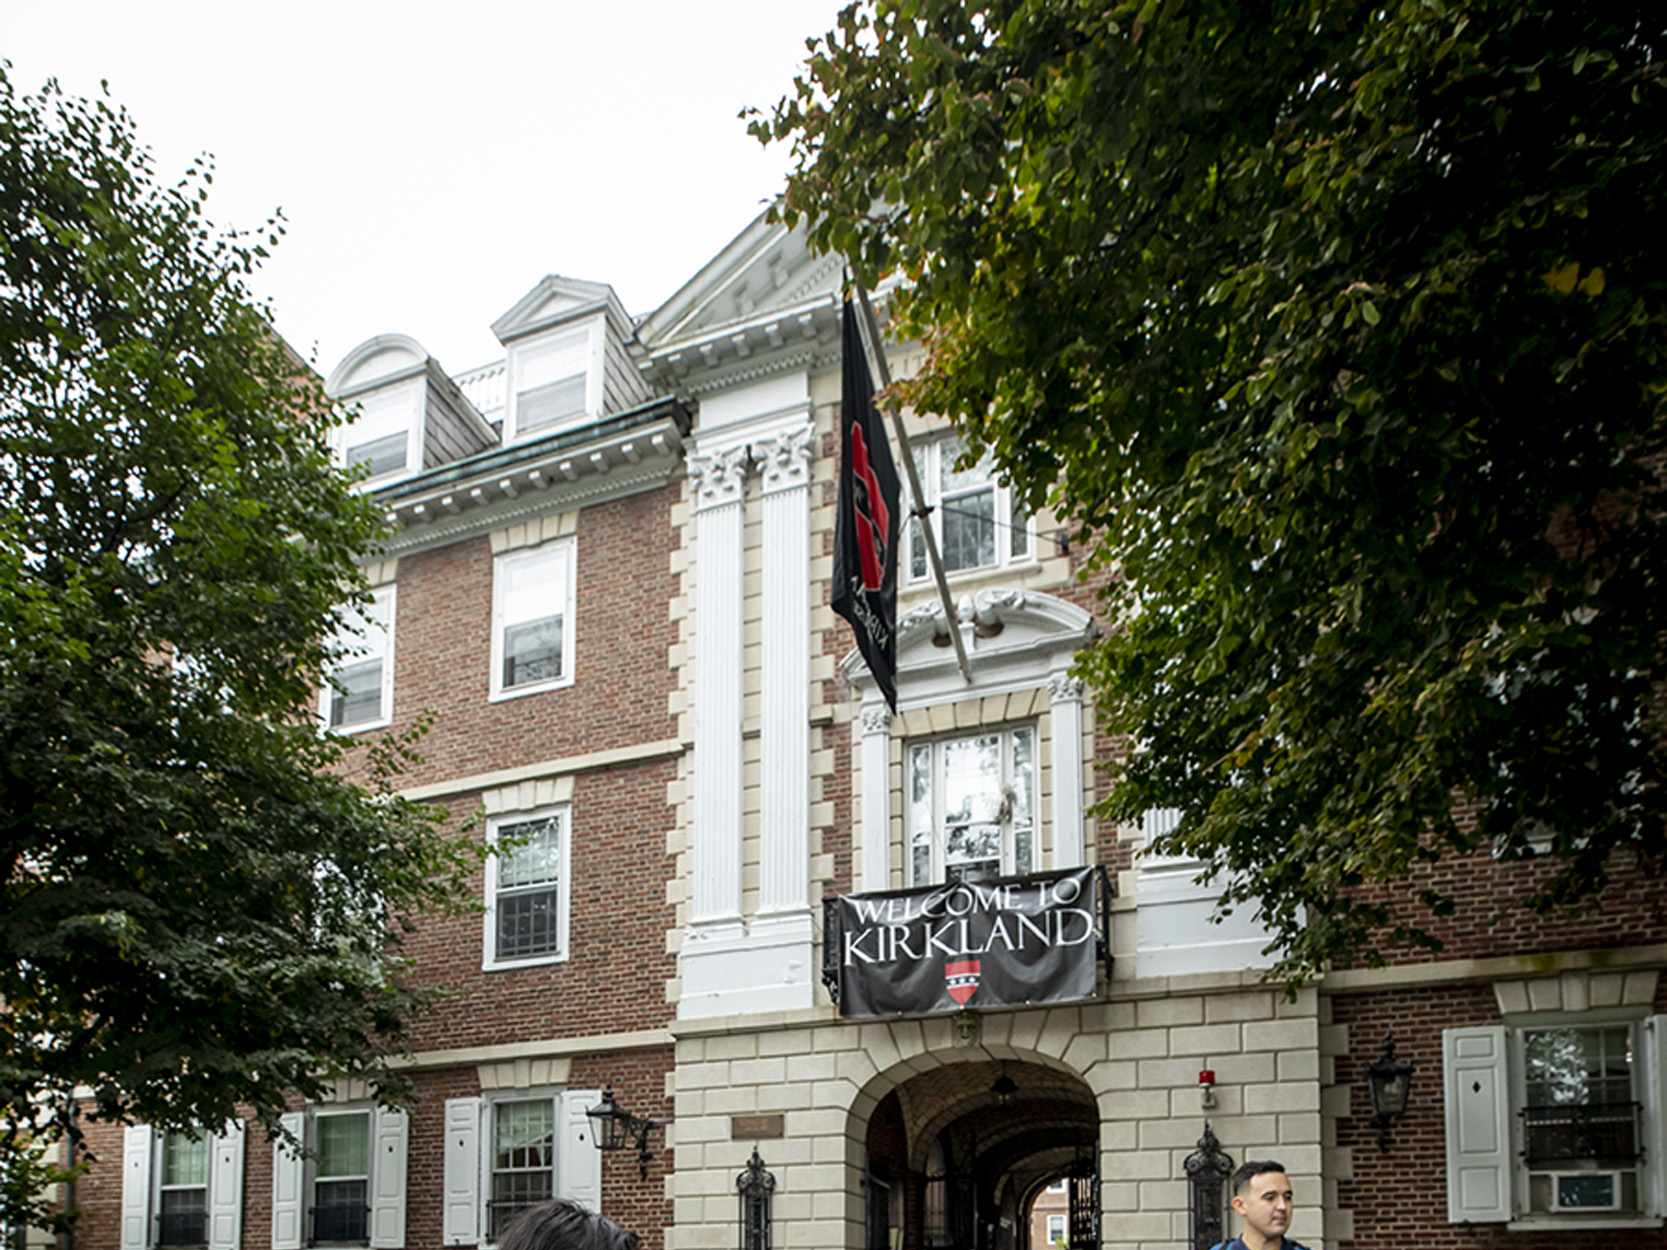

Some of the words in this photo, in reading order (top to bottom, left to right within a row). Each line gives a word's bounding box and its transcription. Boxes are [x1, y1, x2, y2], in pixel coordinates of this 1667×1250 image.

[853, 883, 1022, 925] WELCOME
[1032, 878, 1081, 906] TO
[844, 908, 1094, 966] KIRKLAND
